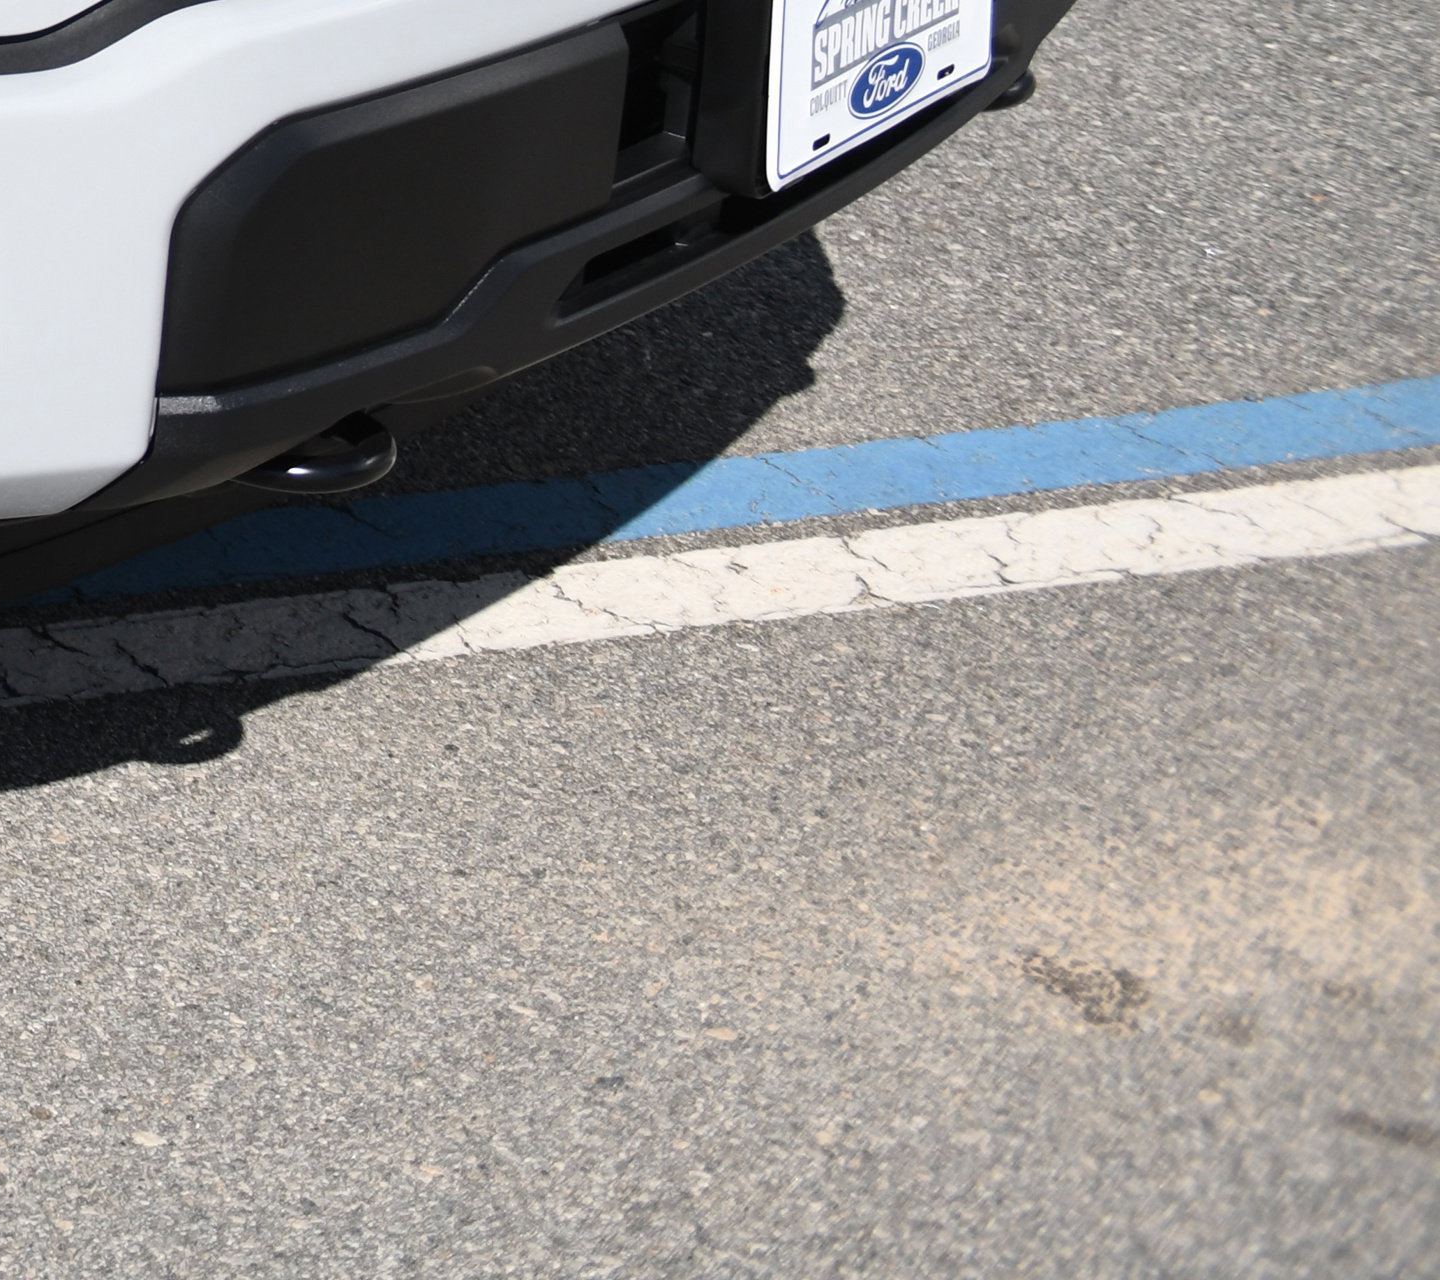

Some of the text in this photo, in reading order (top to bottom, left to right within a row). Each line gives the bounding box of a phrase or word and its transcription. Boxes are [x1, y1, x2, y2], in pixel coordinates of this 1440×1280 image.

[927, 20, 961, 52] GEORGIA
[809, 78, 848, 117] COLQUITT
[862, 53, 910, 109] Ford
